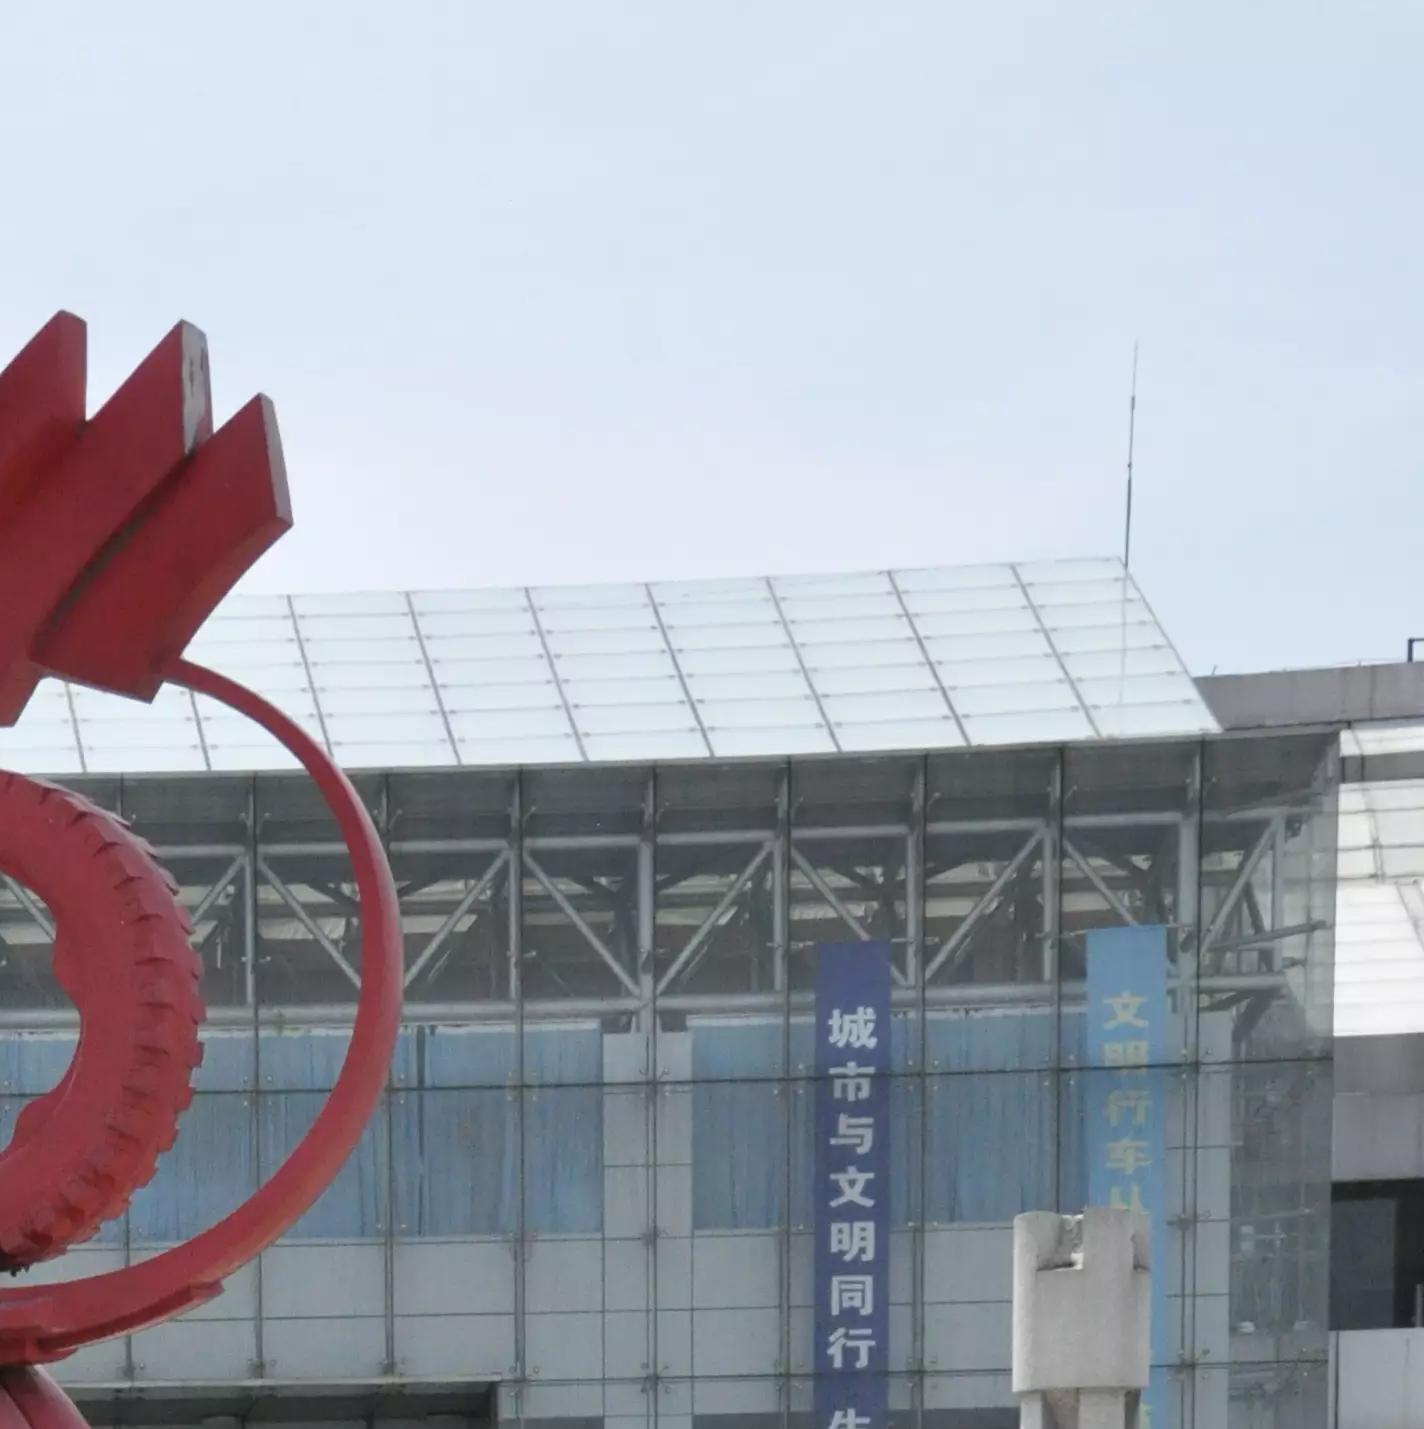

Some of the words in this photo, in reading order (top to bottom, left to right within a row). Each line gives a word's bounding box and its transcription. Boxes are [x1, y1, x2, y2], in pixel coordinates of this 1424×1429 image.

[827, 1006, 878, 1369] 城市与文明同行
